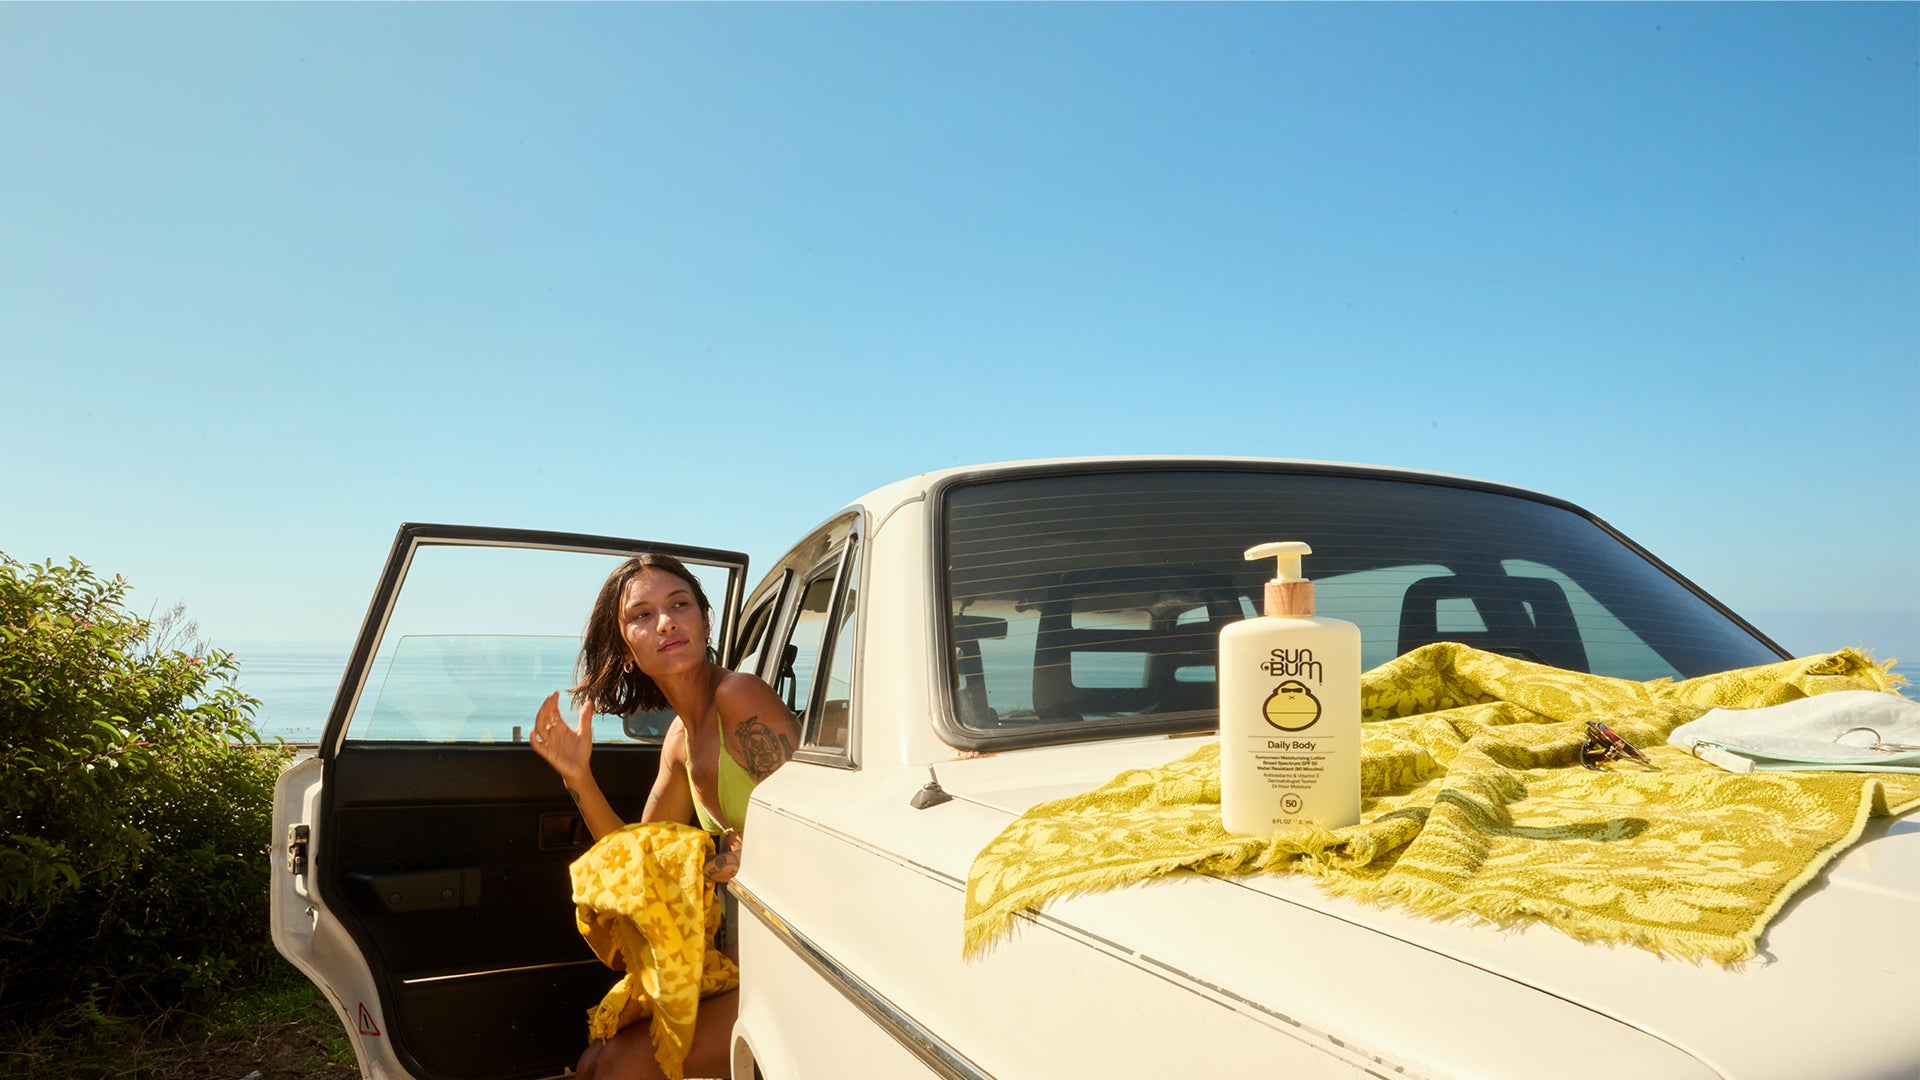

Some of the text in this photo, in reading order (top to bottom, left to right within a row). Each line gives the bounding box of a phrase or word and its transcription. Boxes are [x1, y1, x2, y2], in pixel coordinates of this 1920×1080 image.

[1267, 740, 1316, 751] Daily Body
[1285, 799, 1297, 808] 50
